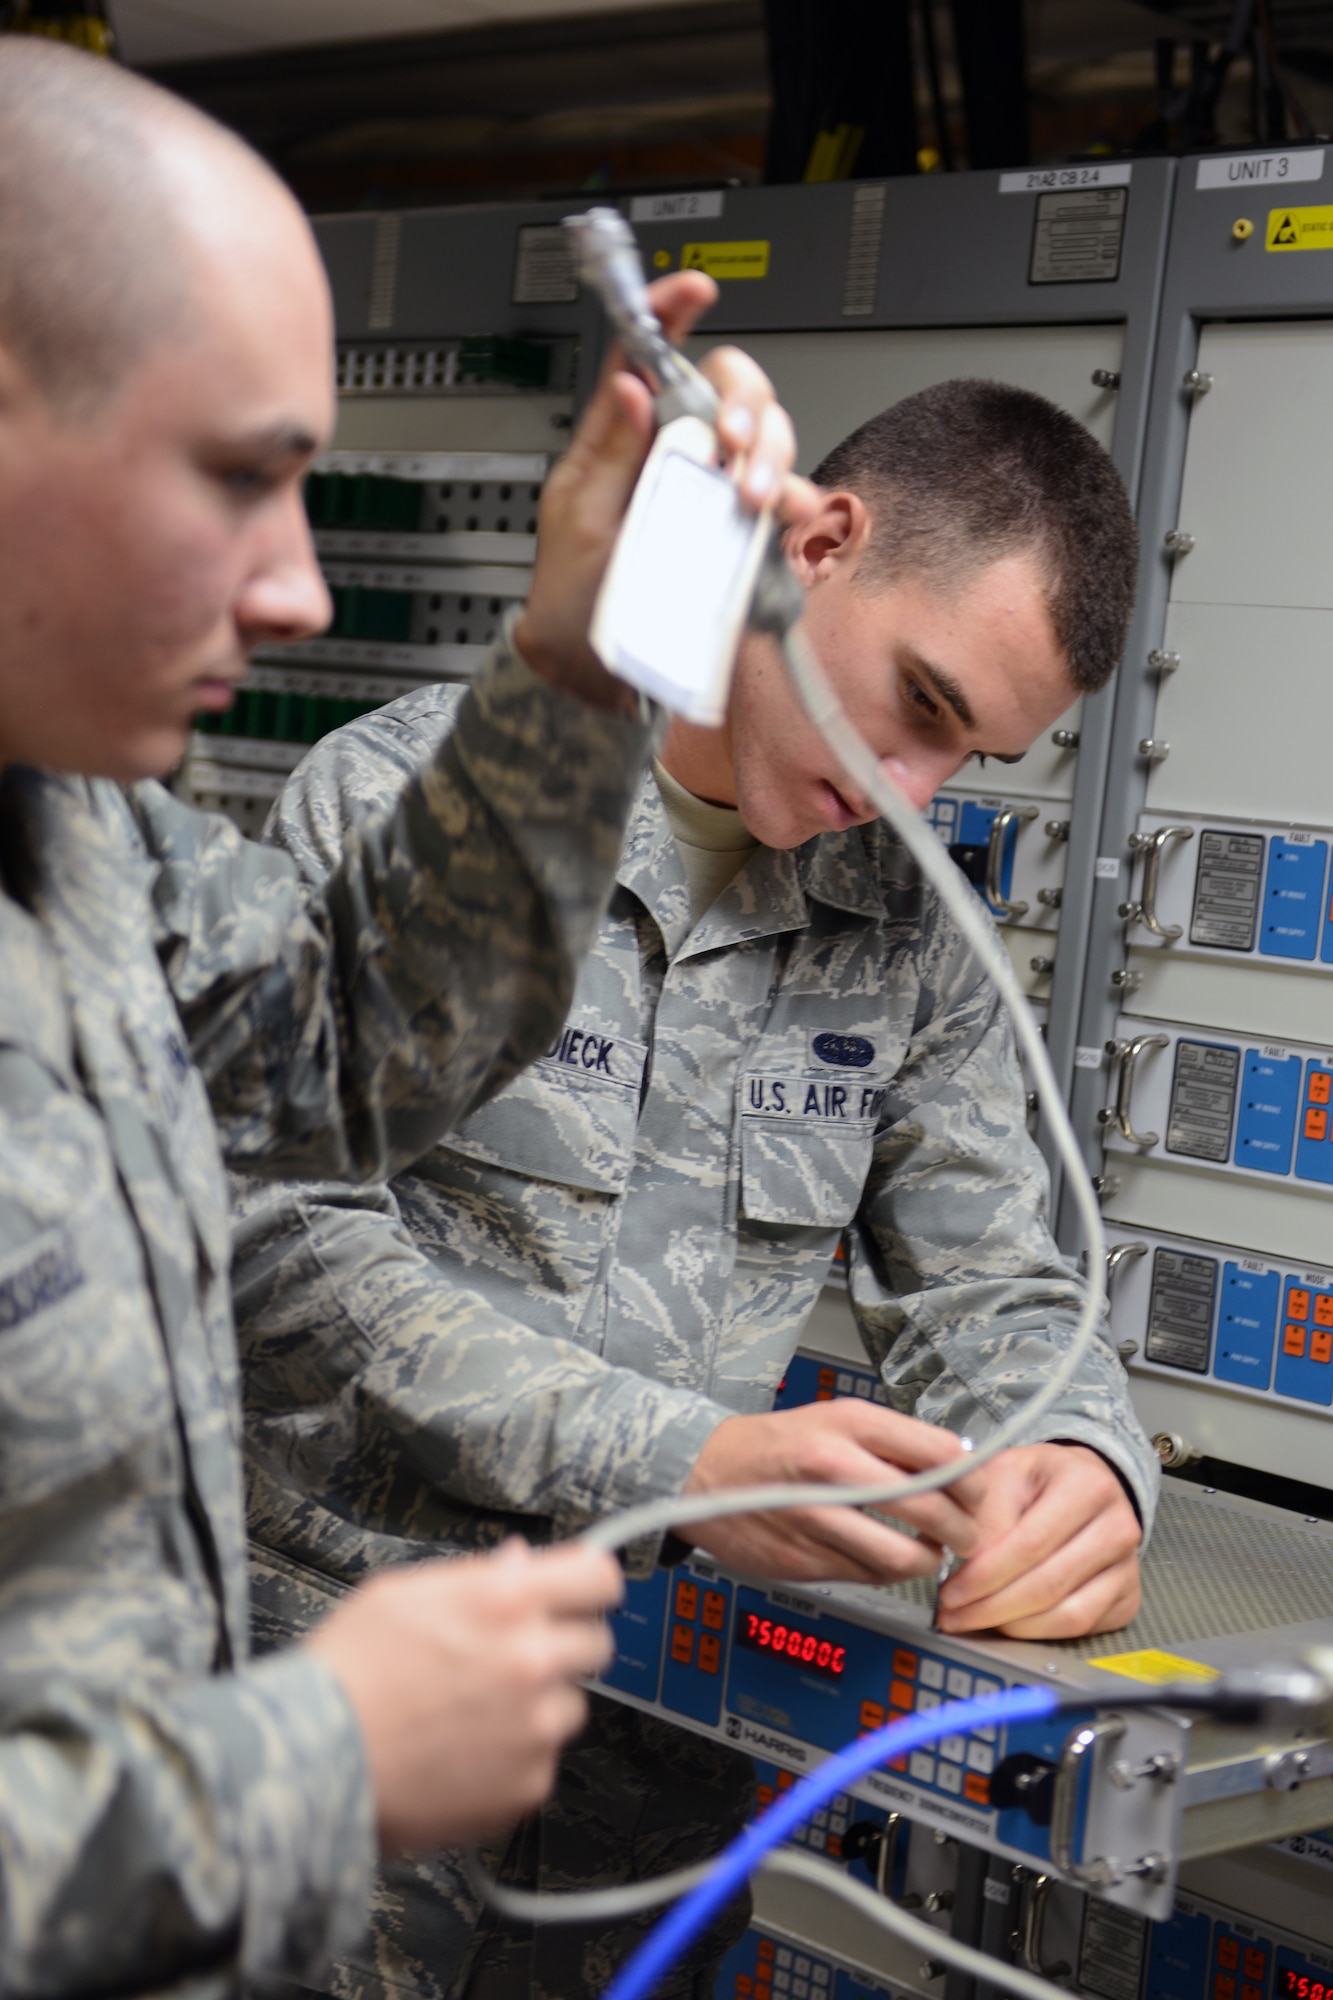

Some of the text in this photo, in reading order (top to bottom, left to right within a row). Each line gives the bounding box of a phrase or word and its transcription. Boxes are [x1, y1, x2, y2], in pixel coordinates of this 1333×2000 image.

[1228, 156, 1290, 181] UNIT 3
[1026, 172, 1057, 188] 21A2
[1060, 171, 1078, 186] CB
[687, 196, 699, 214] 2
[1288, 832, 1311, 843] FAULT
[1263, 1046, 1286, 1057] FAULT
[751, 1079, 791, 1114] U.S.
[804, 1084, 847, 1118] AIR
[1241, 1259, 1265, 1272] FAULT
[1304, 1273, 1327, 1286] MODE
[744, 1727, 807, 1763] HARRIS
[1307, 1844, 1333, 1862] HA
